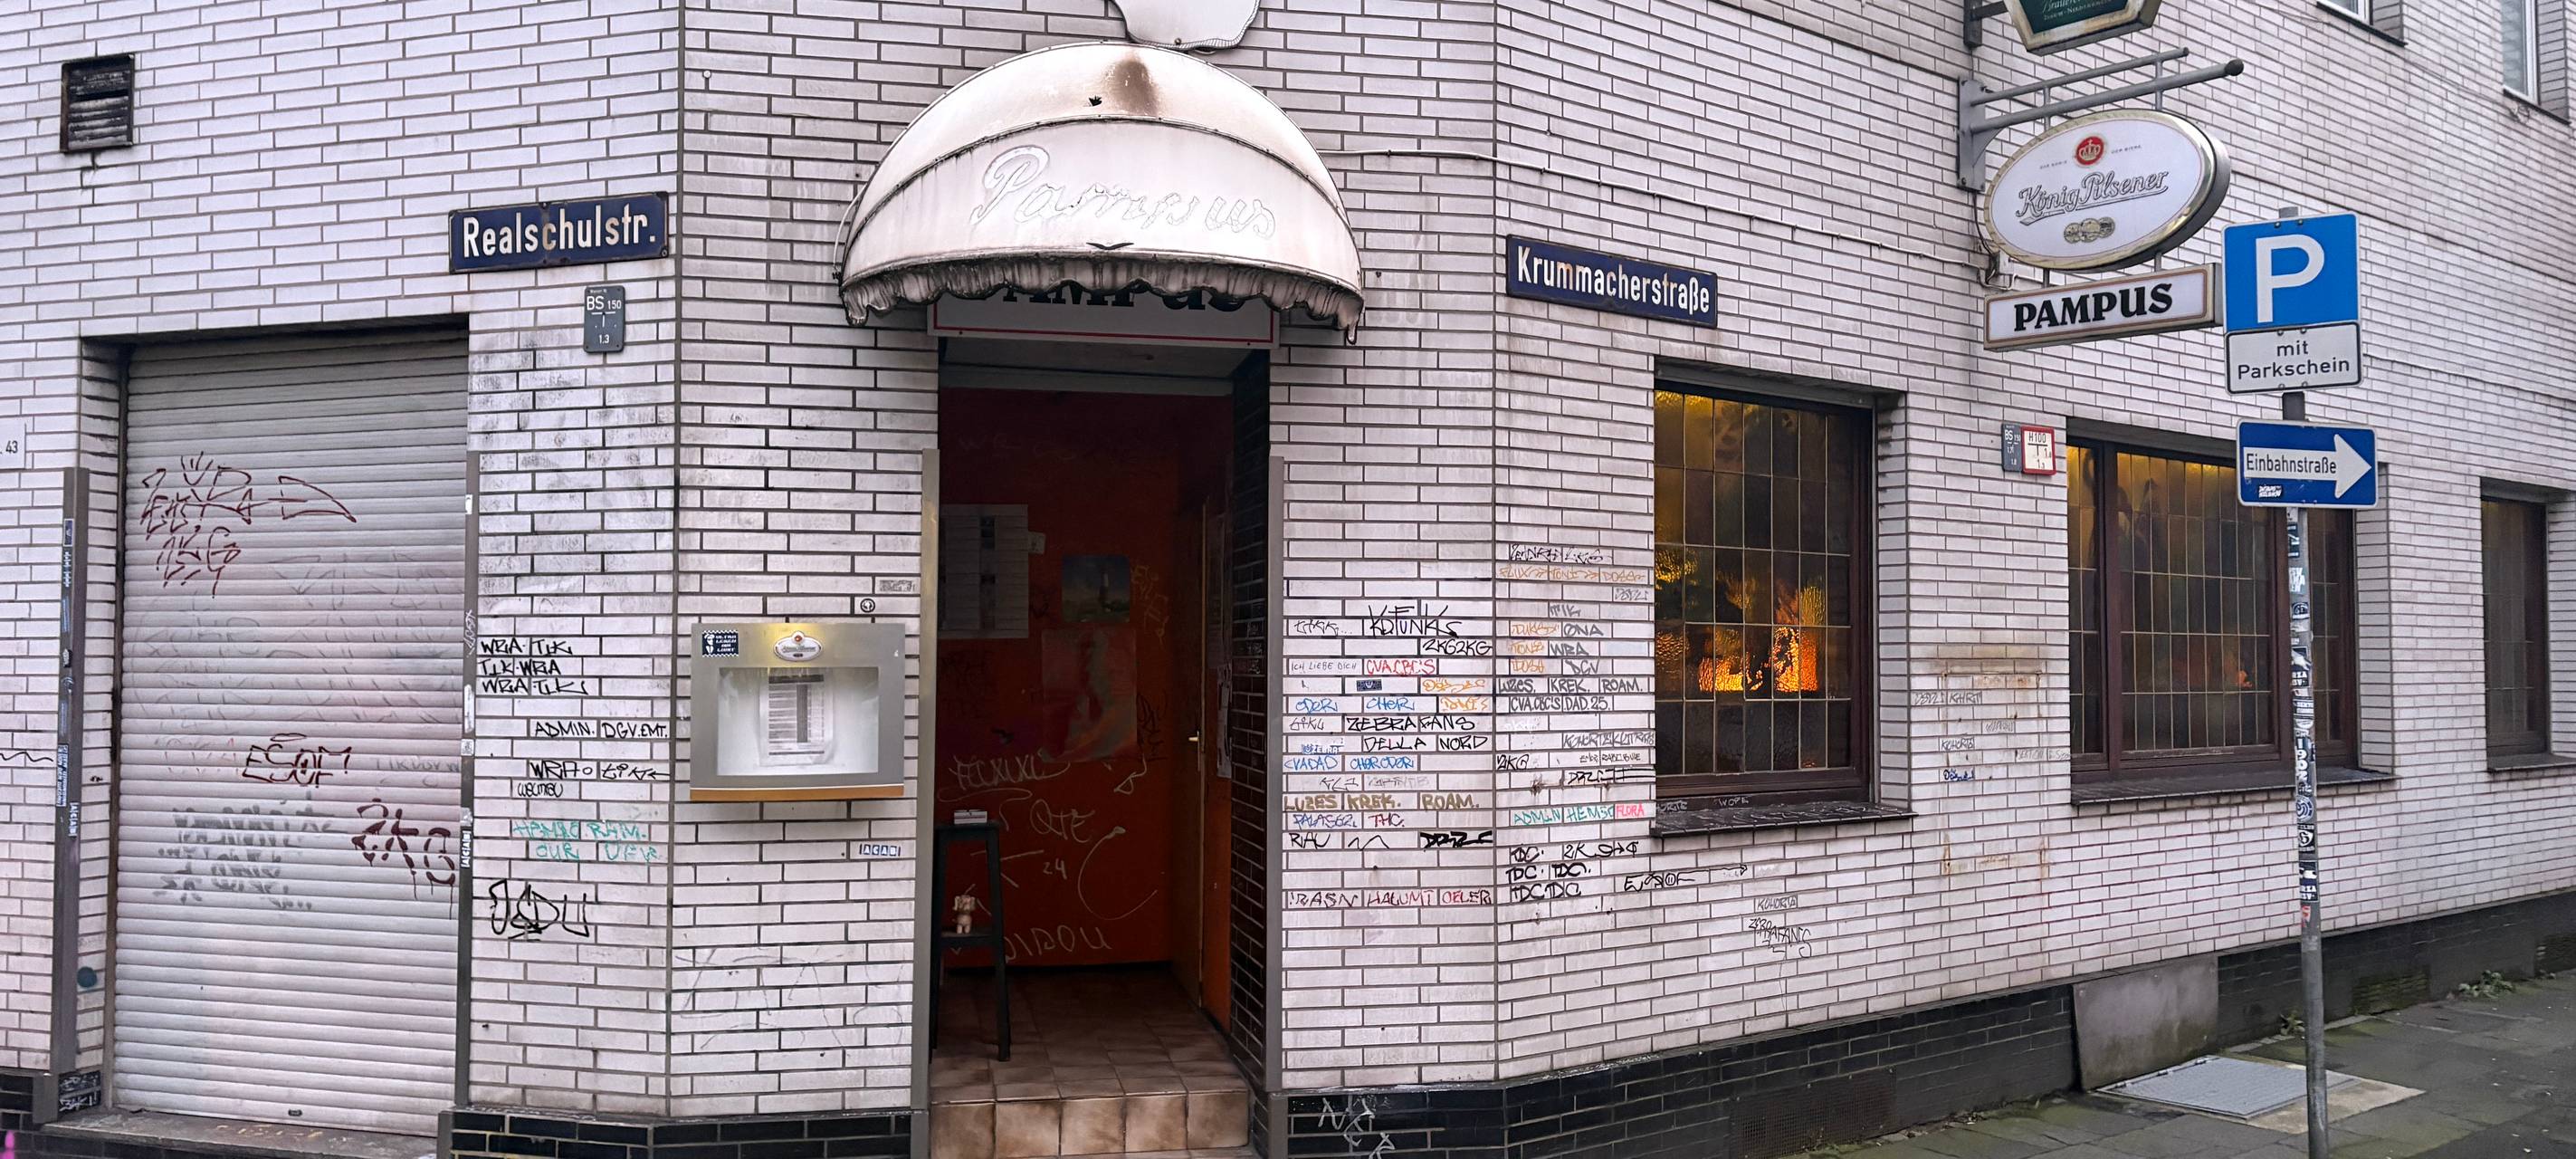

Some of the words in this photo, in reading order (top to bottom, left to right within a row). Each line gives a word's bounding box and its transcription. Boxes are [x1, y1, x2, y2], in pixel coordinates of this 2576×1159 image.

[2016, 184, 2081, 218] König
[2081, 170, 2170, 204] Pilsener
[463, 203, 656, 258] Realschulstr.
[1517, 245, 1710, 315] Krummacherstraße
[2256, 234, 2324, 323] P
[587, 295, 605, 311] BS
[607, 299, 622, 310] 150
[2013, 283, 2173, 332] PAMPUS
[2277, 340, 2308, 357] mit
[2237, 358, 2350, 380] Parkschein
[5, 440, 18, 453] 43
[2246, 453, 2337, 474] Einbahnstraße
